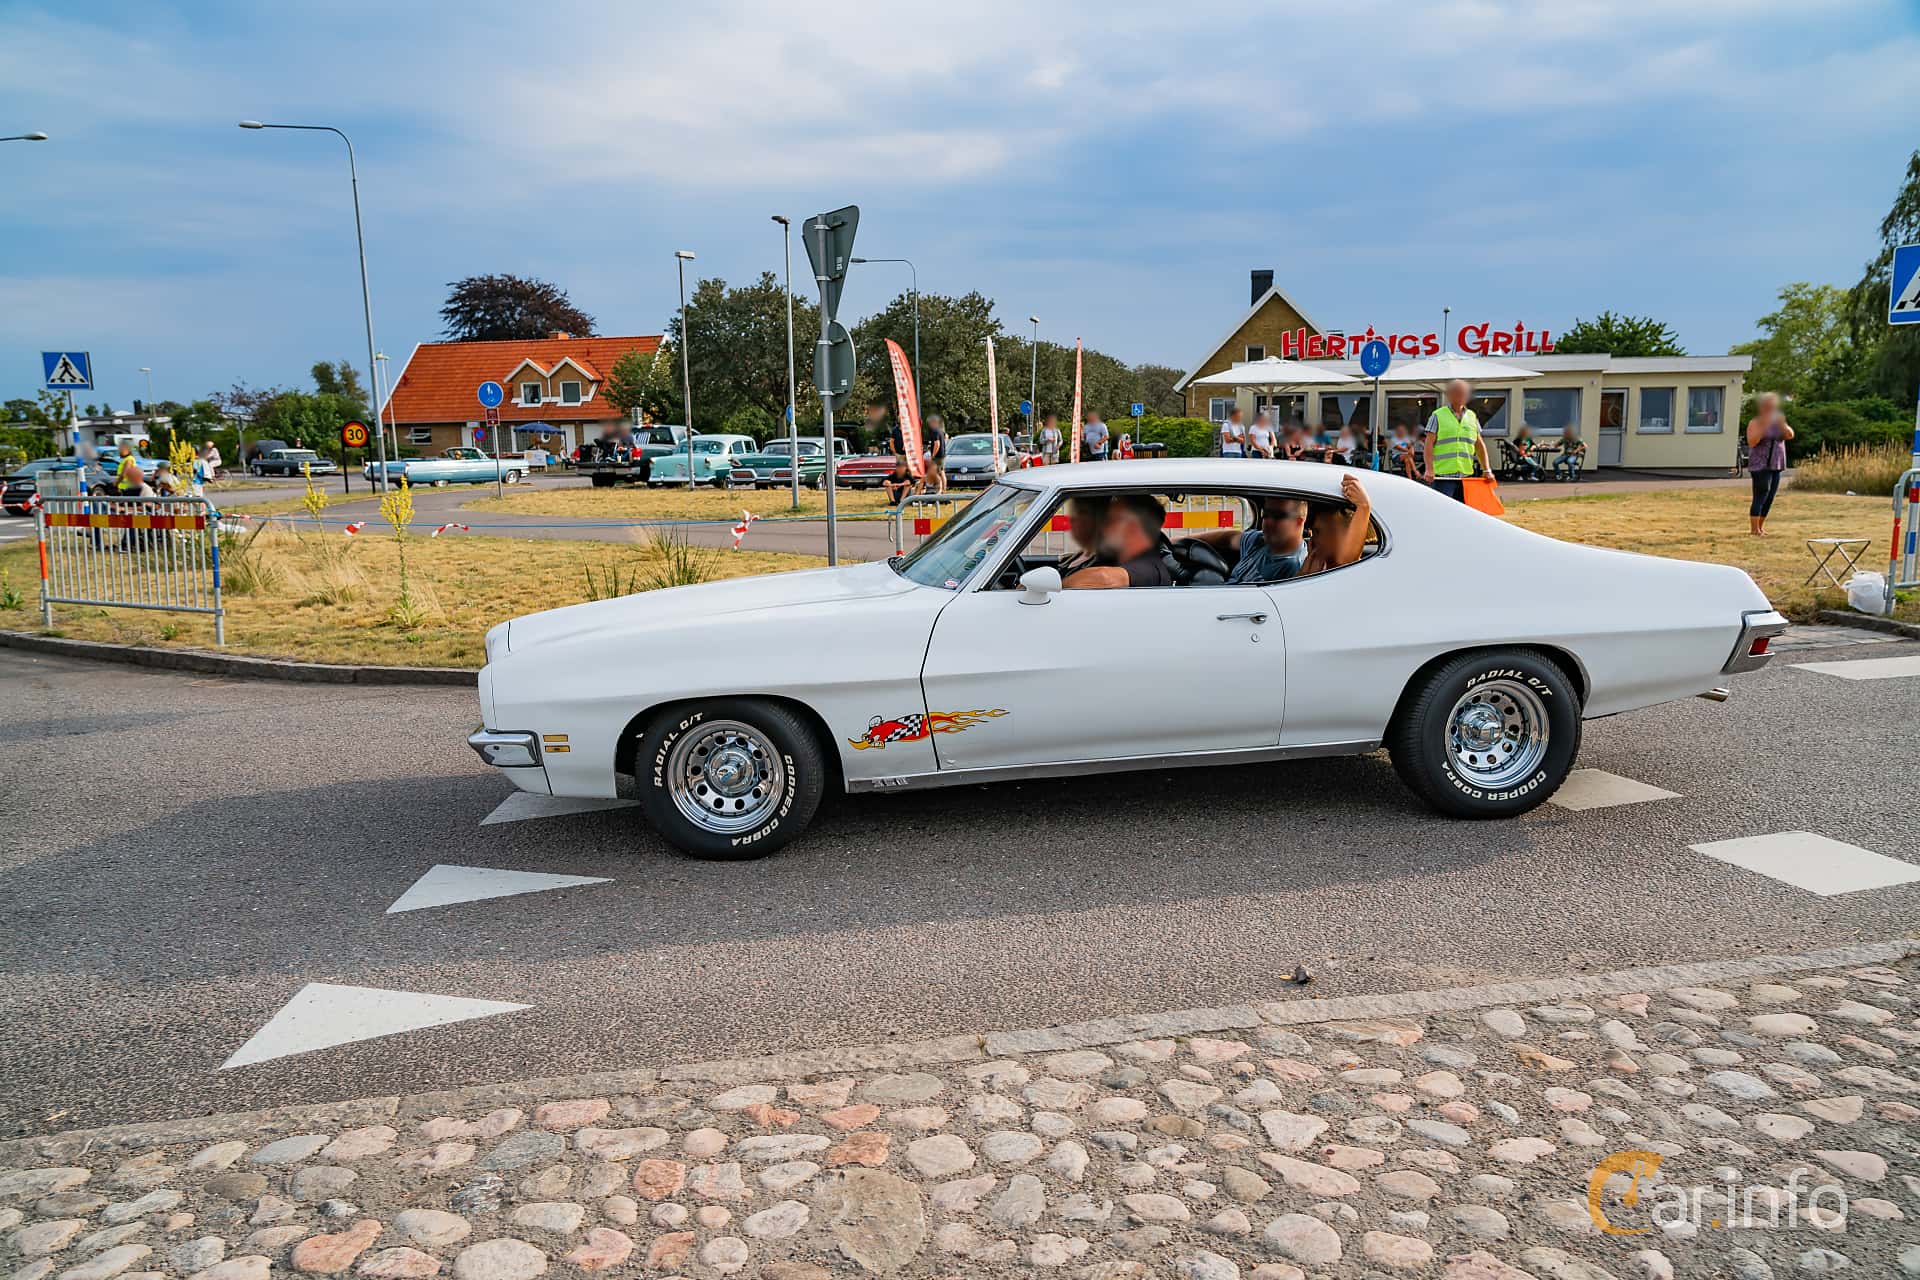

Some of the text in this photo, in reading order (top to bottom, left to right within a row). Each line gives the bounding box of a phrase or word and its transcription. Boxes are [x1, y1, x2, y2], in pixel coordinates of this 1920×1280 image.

[347, 429, 364, 441] 30
[1466, 669, 1553, 697] RADIAL G/T
[653, 712, 703, 787] RADIAL G/T
[731, 754, 796, 847] COOPER COBRA
[1441, 760, 1548, 801] COOPER COBRA
